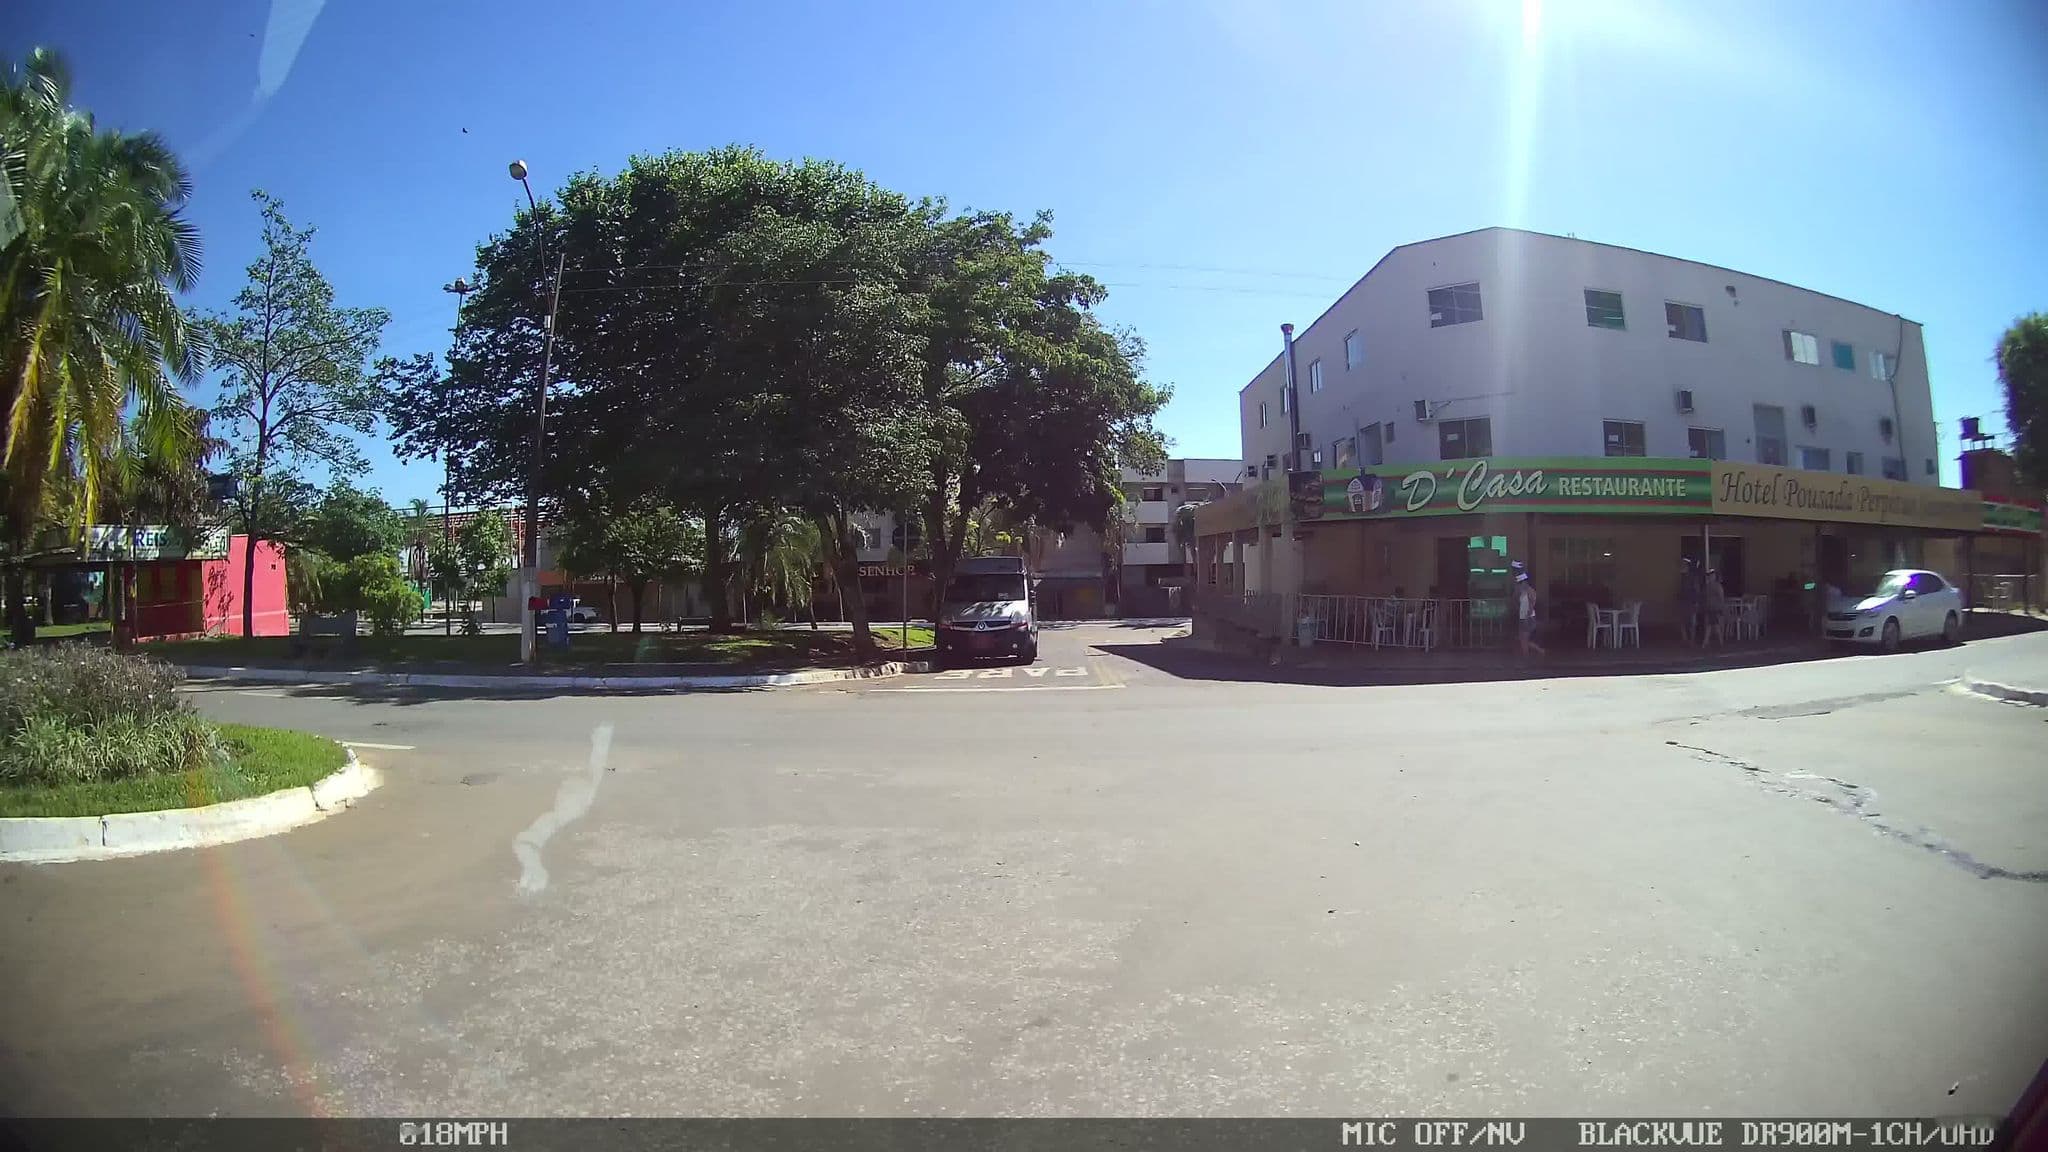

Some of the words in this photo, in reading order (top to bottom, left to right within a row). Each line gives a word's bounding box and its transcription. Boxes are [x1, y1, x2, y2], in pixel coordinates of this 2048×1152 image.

[1558, 476, 1687, 498] RESTAURANTE
[1719, 471, 1783, 506] Hotel
[1784, 479, 1853, 511] Pousada
